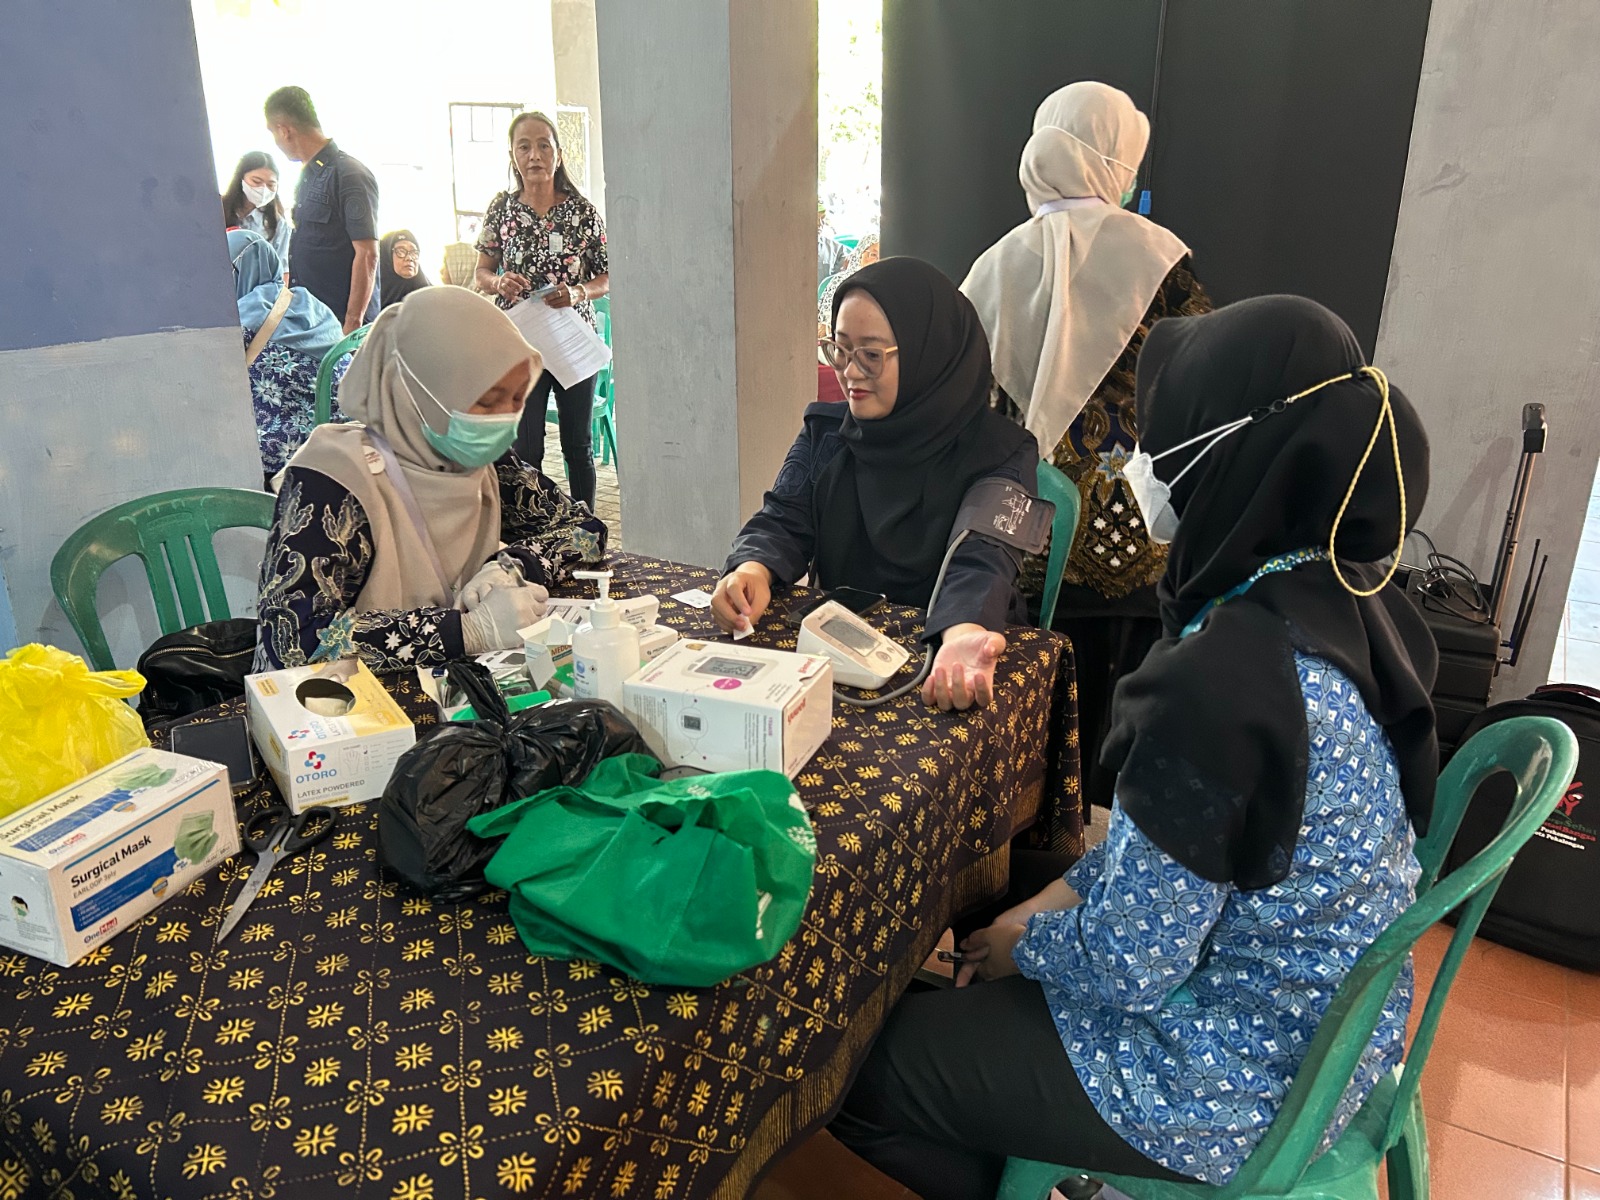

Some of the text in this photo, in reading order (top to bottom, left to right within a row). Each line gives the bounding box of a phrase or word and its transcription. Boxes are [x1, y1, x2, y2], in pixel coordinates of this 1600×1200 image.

[295, 768, 337, 784] OTORO
[297, 788, 321, 799] LATEX
[322, 779, 365, 793] POWDERED
[71, 851, 120, 888] Surgical
[121, 835, 152, 860] Mask
[73, 877, 103, 899] EARLOOP
